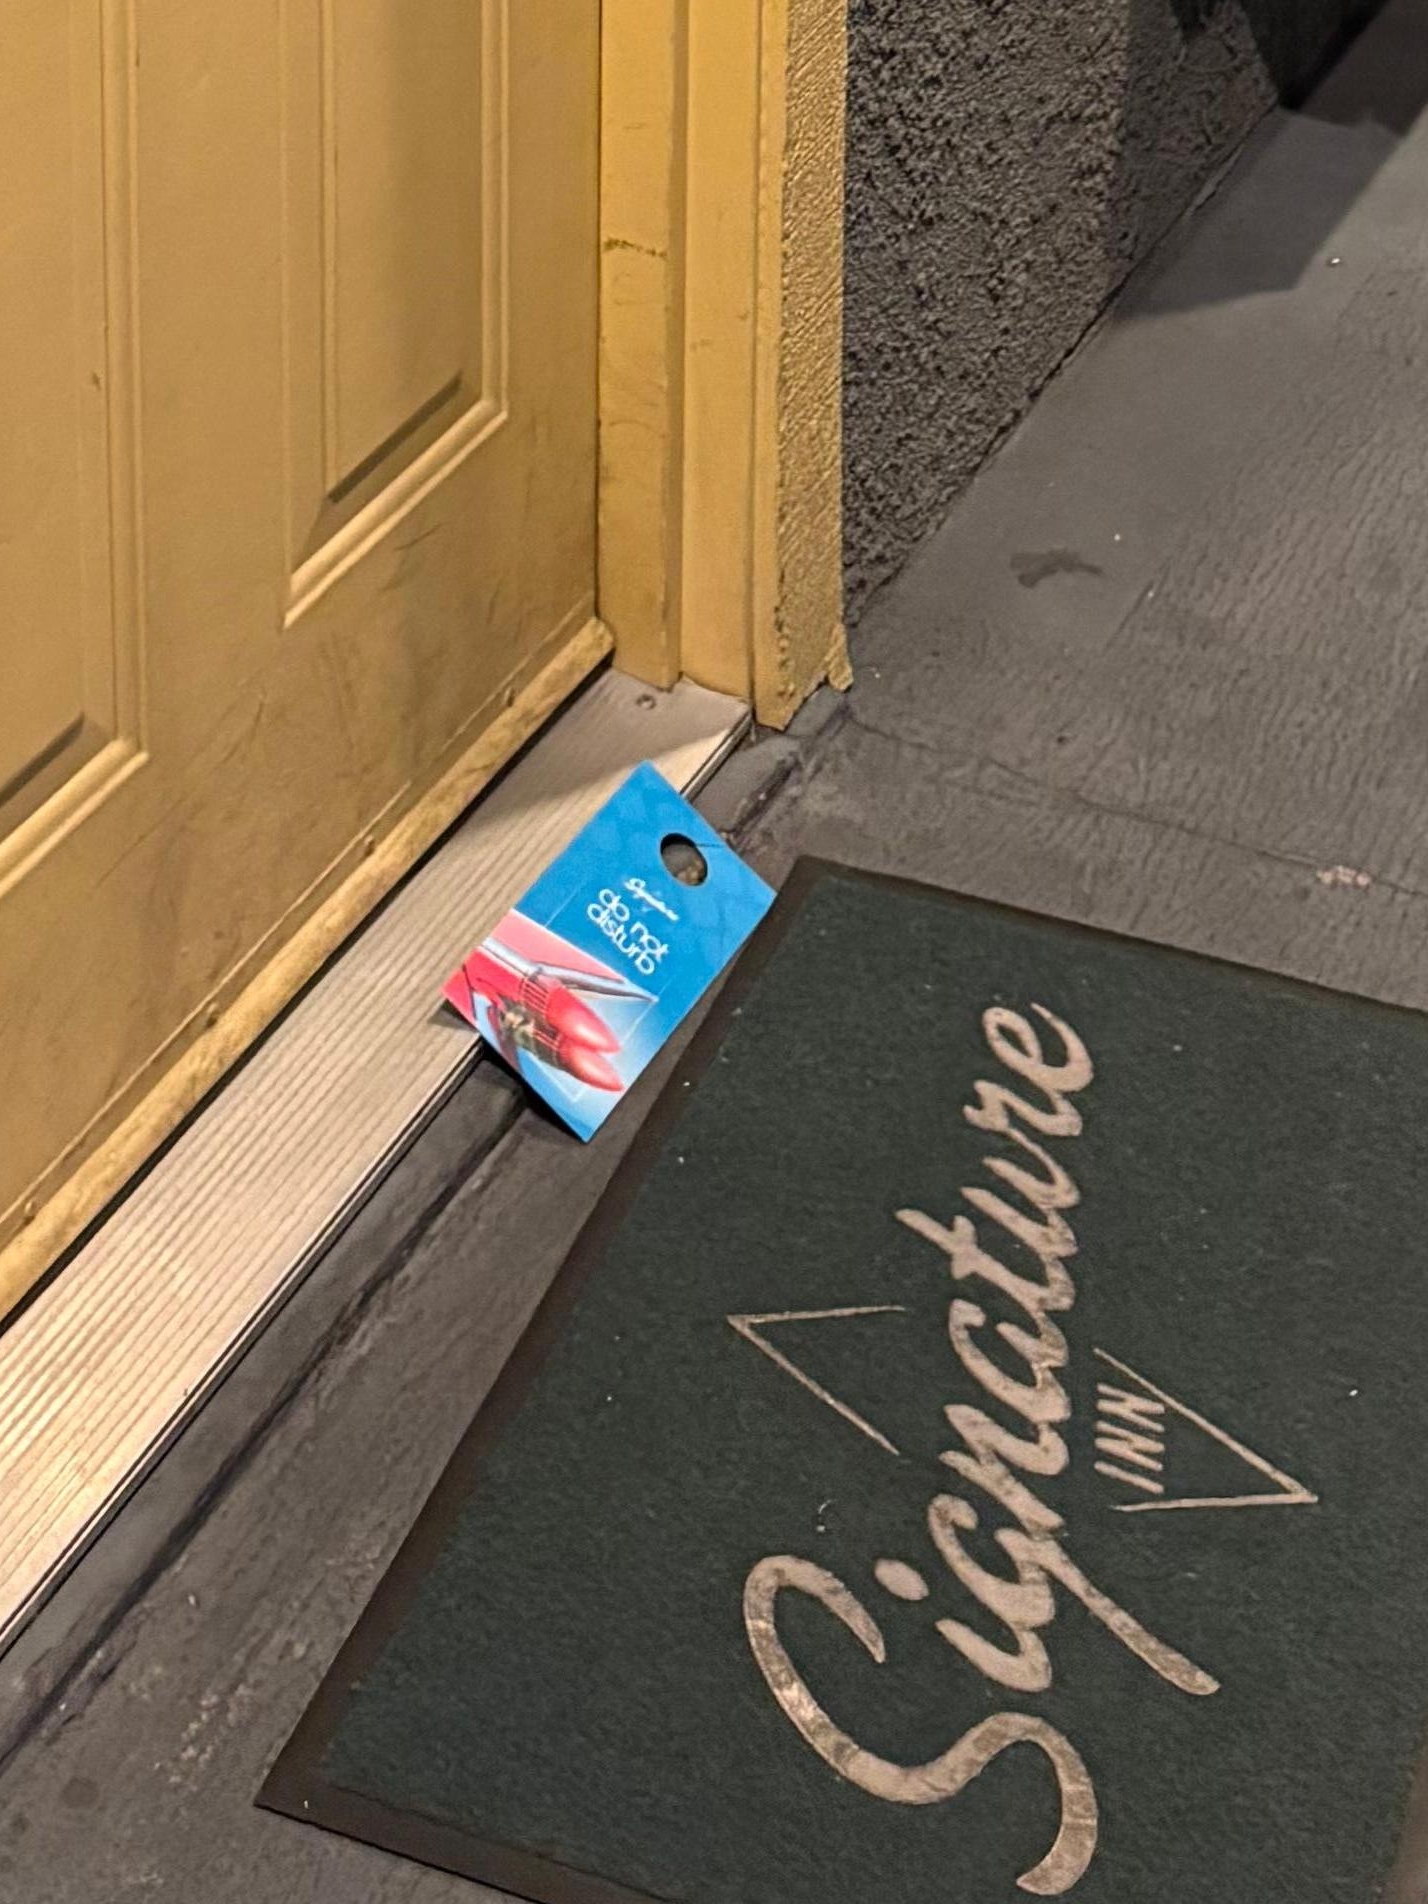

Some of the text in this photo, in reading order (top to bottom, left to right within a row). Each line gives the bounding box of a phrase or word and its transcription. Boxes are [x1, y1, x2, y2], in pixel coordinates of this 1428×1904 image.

[586, 903, 655, 976] disturb
[598, 888, 631, 922] do
[629, 921, 669, 964] not
[742, 1002, 1220, 1896] Signature
[1094, 1384, 1165, 1494] INN
